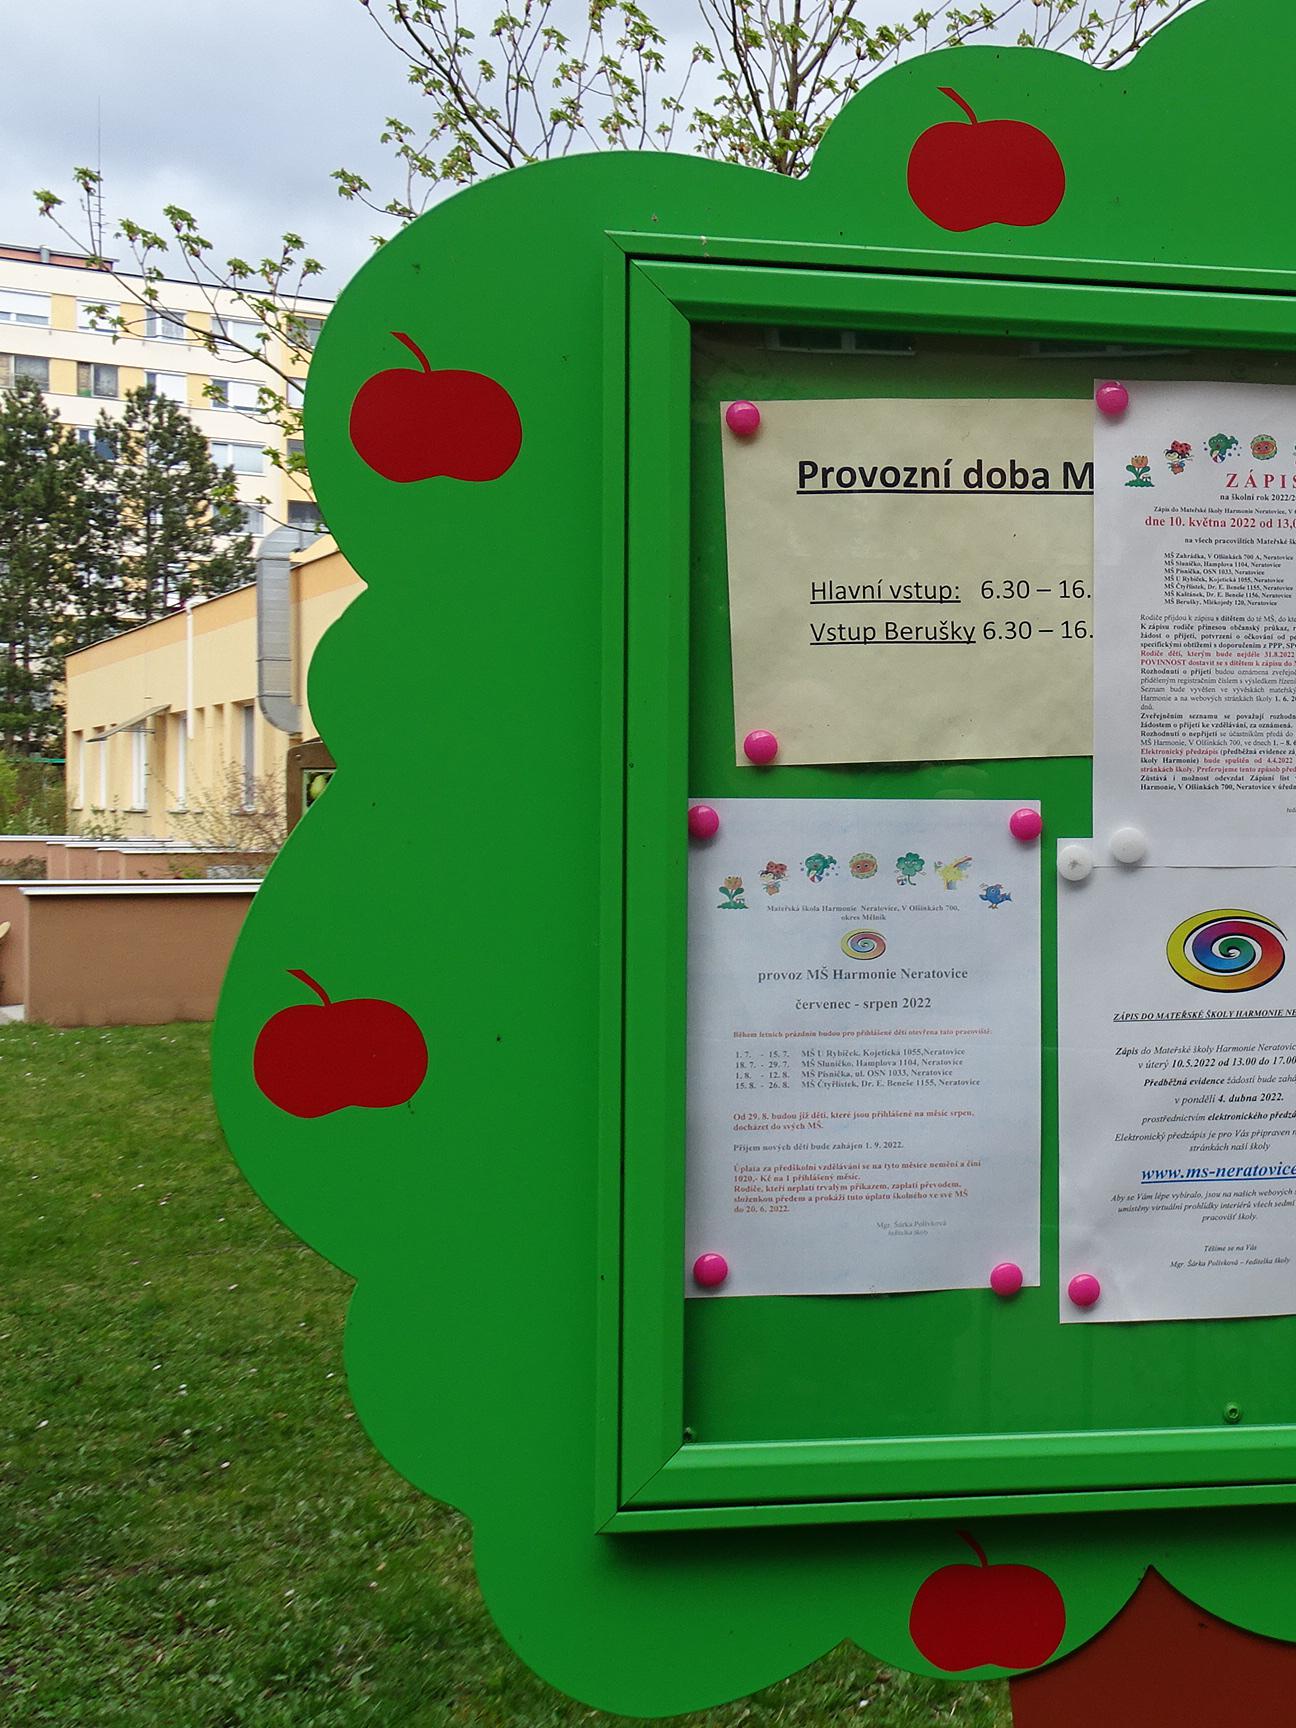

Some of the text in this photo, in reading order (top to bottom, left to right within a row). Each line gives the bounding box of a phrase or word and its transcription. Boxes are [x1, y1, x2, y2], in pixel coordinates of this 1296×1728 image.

[798, 459, 951, 489] Provozní
[963, 459, 1049, 490] doba
[1231, 493, 1253, 502] školní
[1145, 516, 1165, 526] dne
[1170, 516, 1184, 526] 10.
[1189, 517, 1226, 527] května
[1230, 517, 1255, 527] 2022
[1259, 518, 1272, 528] od
[811, 578, 882, 600] Hlavní
[890, 582, 960, 605] vstup:
[981, 580, 1030, 600] 6.30
[811, 622, 875, 646] Vstup
[885, 620, 975, 645] Berušky
[983, 621, 1031, 640] 6.30
[758, 967, 967, 983] provoz MŠ Harmonie Neratovice
[795, 999, 850, 1009] červenec
[863, 1000, 897, 1011] srpen
[902, 997, 930, 1008] 2022
[1114, 1011, 1139, 1019] ZÁPIS
[1157, 1009, 1204, 1018] MATEŘSKÉ
[1205, 1009, 1234, 1017] ŠKOLY
[1236, 1009, 1283, 1017] HARMONIE
[1115, 1047, 1138, 1056] Zápis
[1140, 1046, 1151, 1054] do
[1153, 1045, 1191, 1054] Mateřské
[1193, 1044, 1214, 1054] školy
[1215, 1044, 1255, 1052] Harmonie
[1145, 1059, 1169, 1070] úterý
[1172, 1058, 1215, 1068] 10.5.2022
[1218, 1058, 1229, 1066] od
[1232, 1057, 1256, 1066] 13.00
[1258, 1057, 1269, 1065] do
[1273, 1055, 1296, 1064] 17.00
[1143, 1077, 1187, 1086] Předběžná
[1189, 1077, 1224, 1085] evidence
[1226, 1075, 1255, 1084] žádostí
[1257, 1075, 1276, 1083] bude
[1181, 1094, 1215, 1105] pondělí
[1228, 1093, 1257, 1102] dubna
[1142, 1113, 1205, 1124] prostřednictvím
[1207, 1111, 1268, 1120] elektronického
[1114, 1131, 1165, 1141] Elektronický
[1167, 1130, 1205, 1141] předzápis
[1207, 1130, 1216, 1140] je
[1217, 1130, 1232, 1139] pro
[1235, 1129, 1249, 1137] Vás
[1250, 1128, 1290, 1138] připraven
